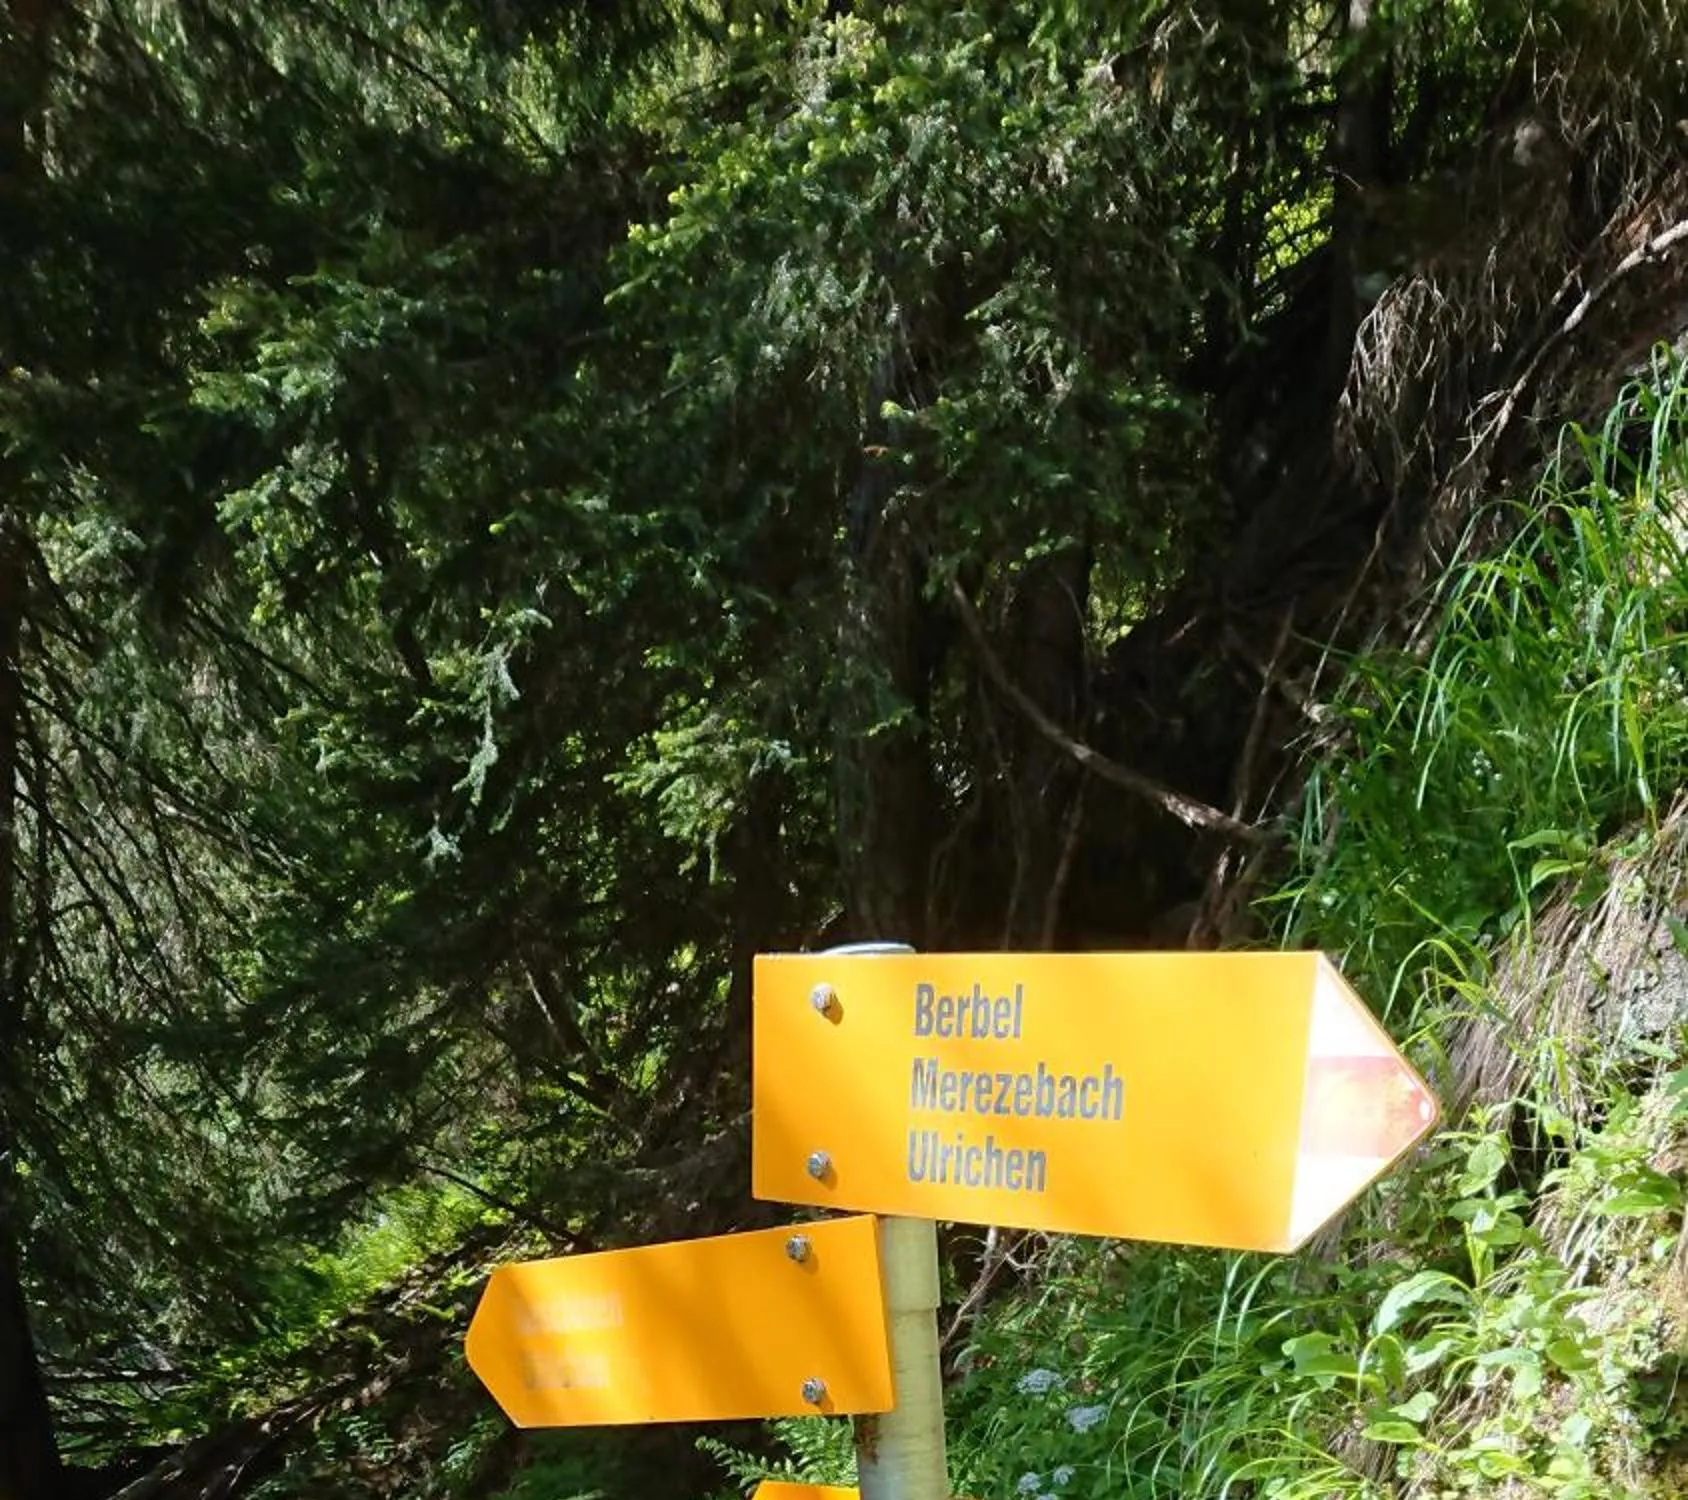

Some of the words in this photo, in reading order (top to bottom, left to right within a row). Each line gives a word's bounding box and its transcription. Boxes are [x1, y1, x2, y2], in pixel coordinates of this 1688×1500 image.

[915, 983, 1023, 1039] Berbel
[911, 1057, 1124, 1120] Merezebach
[907, 1131, 1047, 1192] Ulrichen
